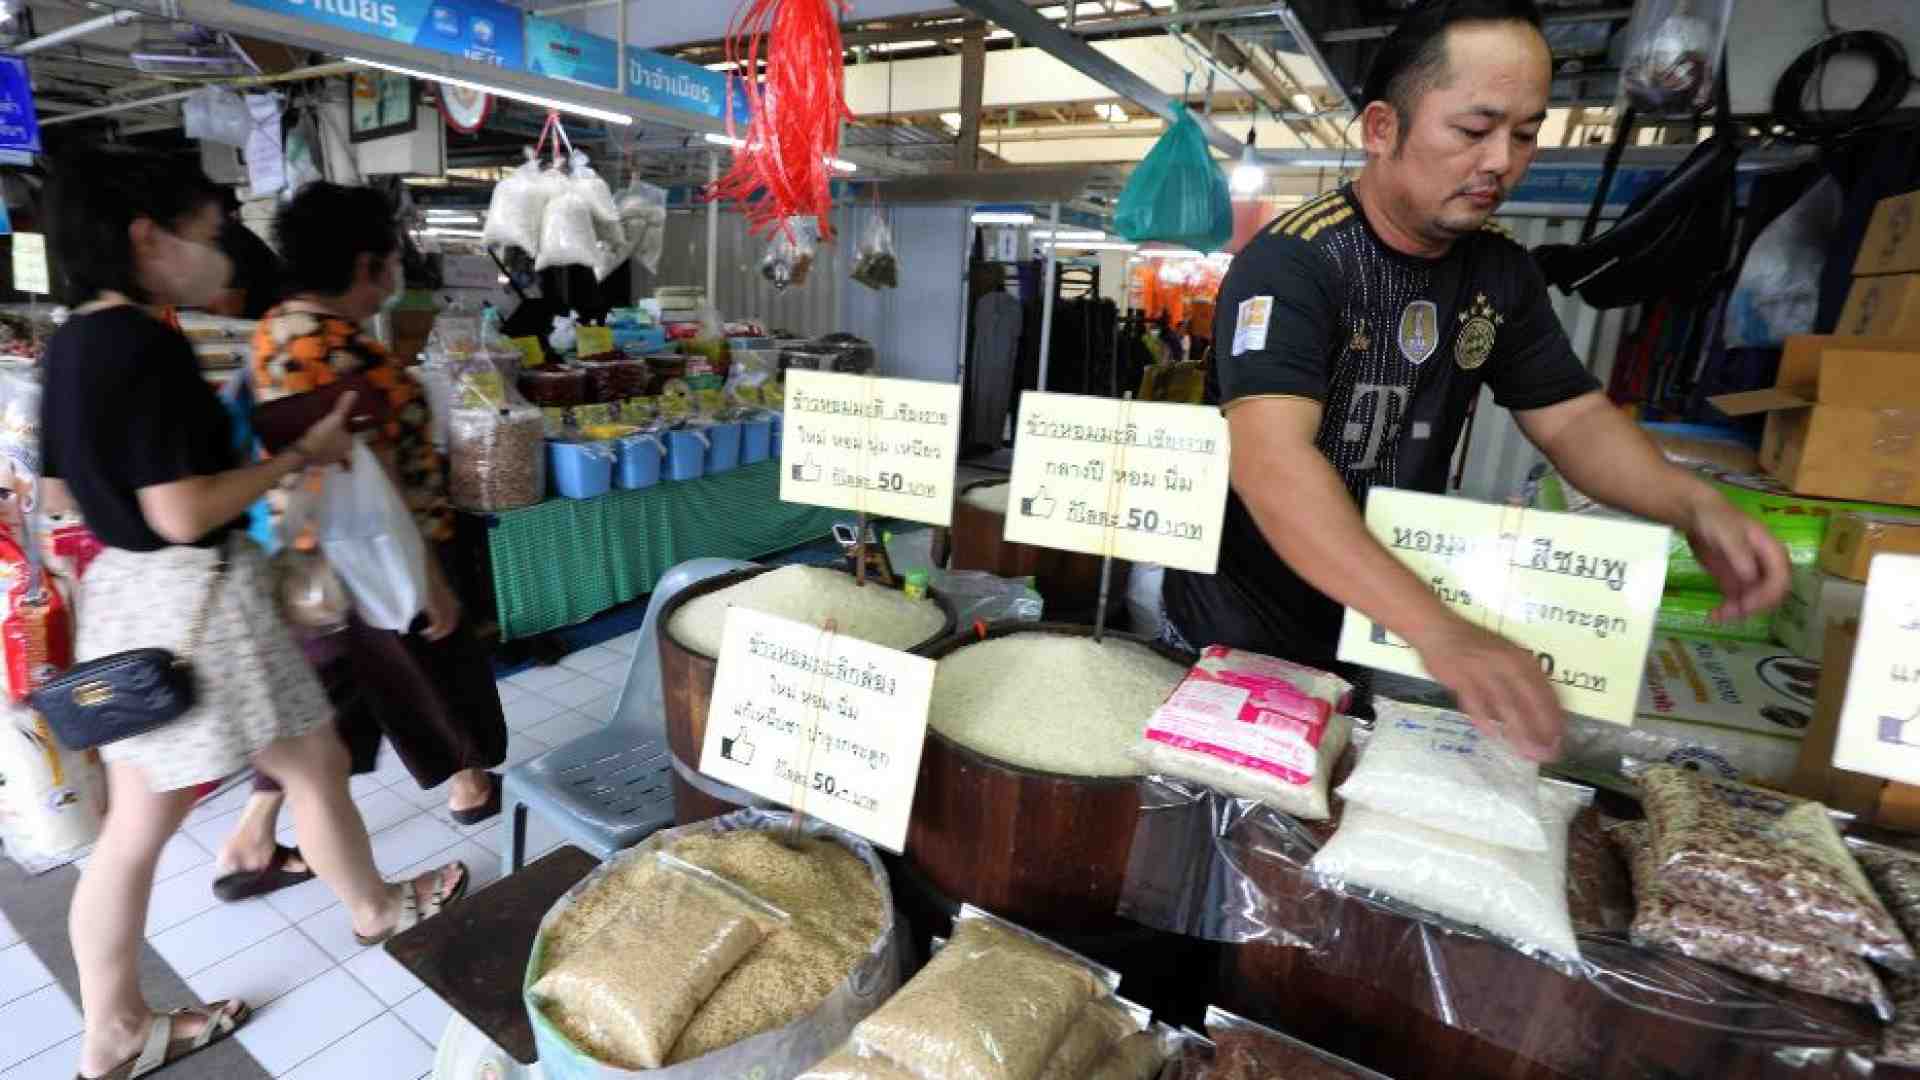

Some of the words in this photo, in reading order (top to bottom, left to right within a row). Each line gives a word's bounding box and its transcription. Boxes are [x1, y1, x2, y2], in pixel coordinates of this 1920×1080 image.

[792, 390, 884, 418] ข้าวหอมมะลิ
[832, 433, 862, 449] หอม
[1026, 411, 1137, 444] ข้าวหอมมะลิ
[878, 471, 904, 491] 50
[909, 482, 937, 498] บาท
[1046, 458, 1104, 483] กลางปี
[1112, 468, 1156, 488] หอม
[1164, 465, 1193, 493] นิ่ม
[1127, 507, 1159, 531] 50
[1165, 519, 1203, 541] บาท
[1531, 537, 1628, 591] สีชมพู
[1561, 668, 1608, 692] บาท
